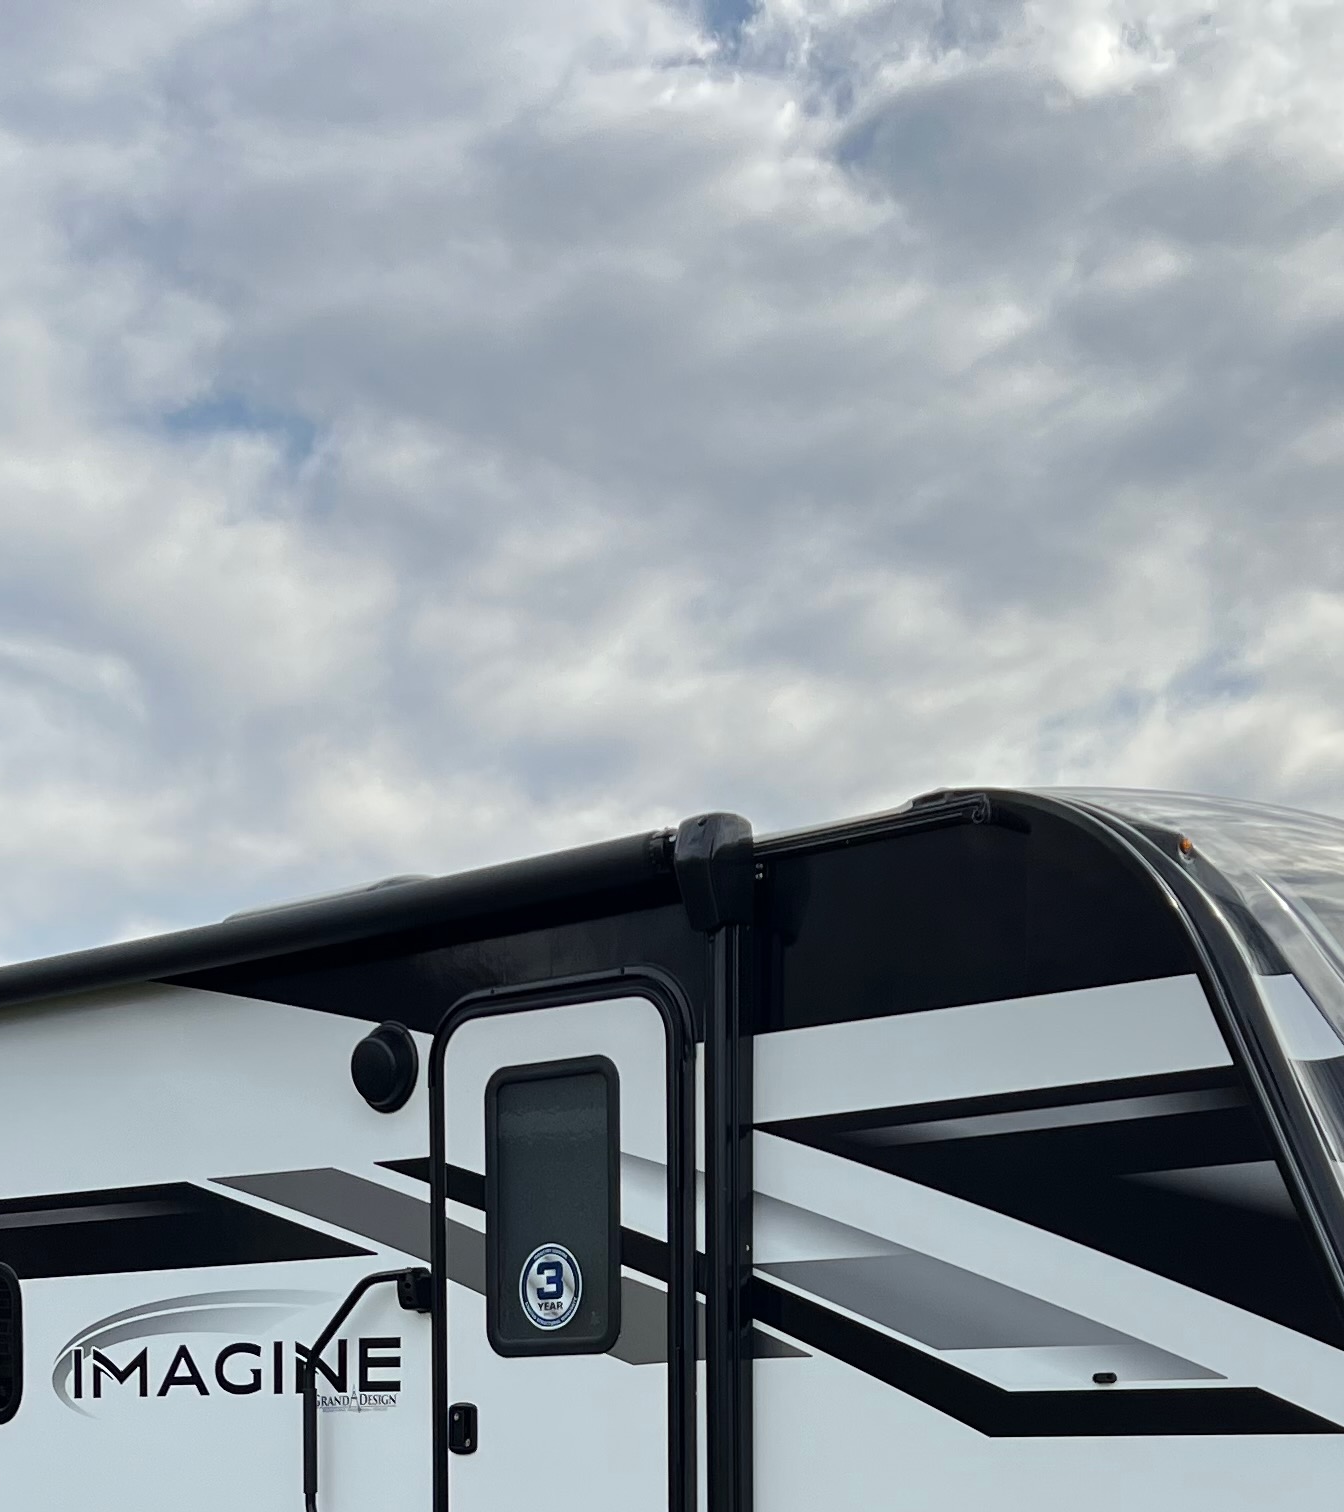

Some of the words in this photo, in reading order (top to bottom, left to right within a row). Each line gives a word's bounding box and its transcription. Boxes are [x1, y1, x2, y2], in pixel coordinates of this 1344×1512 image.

[537, 1261, 564, 1300] 3
[538, 1302, 563, 1312] YEAR
[73, 1337, 401, 1398] IMAGINE
[360, 1393, 397, 1405] DESIGN
